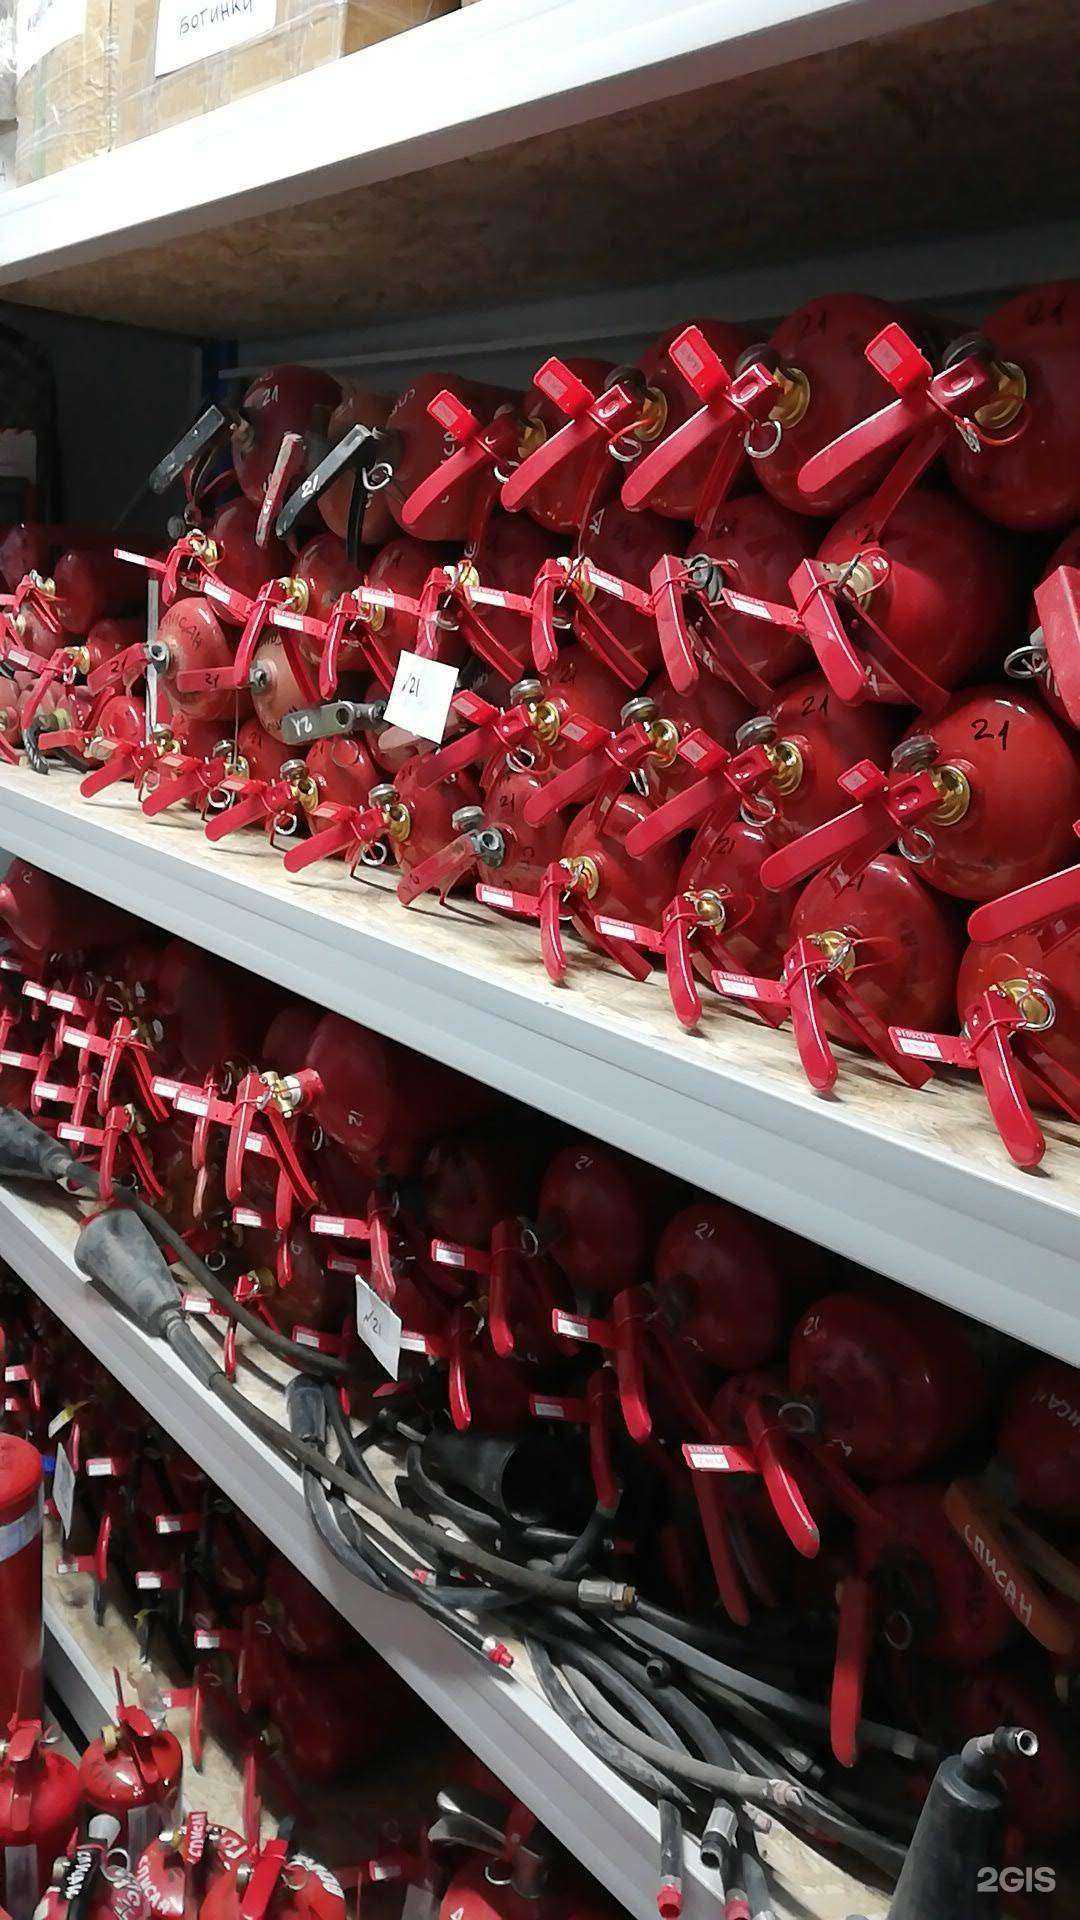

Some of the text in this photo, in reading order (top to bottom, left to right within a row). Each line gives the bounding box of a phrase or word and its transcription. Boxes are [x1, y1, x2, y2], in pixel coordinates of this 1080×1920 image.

[302, 474, 321, 498] 21
[205, 673, 220, 688] 21
[801, 694, 829, 717] 21
[971, 718, 1009, 751] 21
[500, 793, 515, 813] 21
[575, 1155, 594, 1170] 21
[695, 1222, 715, 1241] 21
[803, 1315, 821, 1337] 21
[965, 1524, 1033, 1627] СПИСАН
